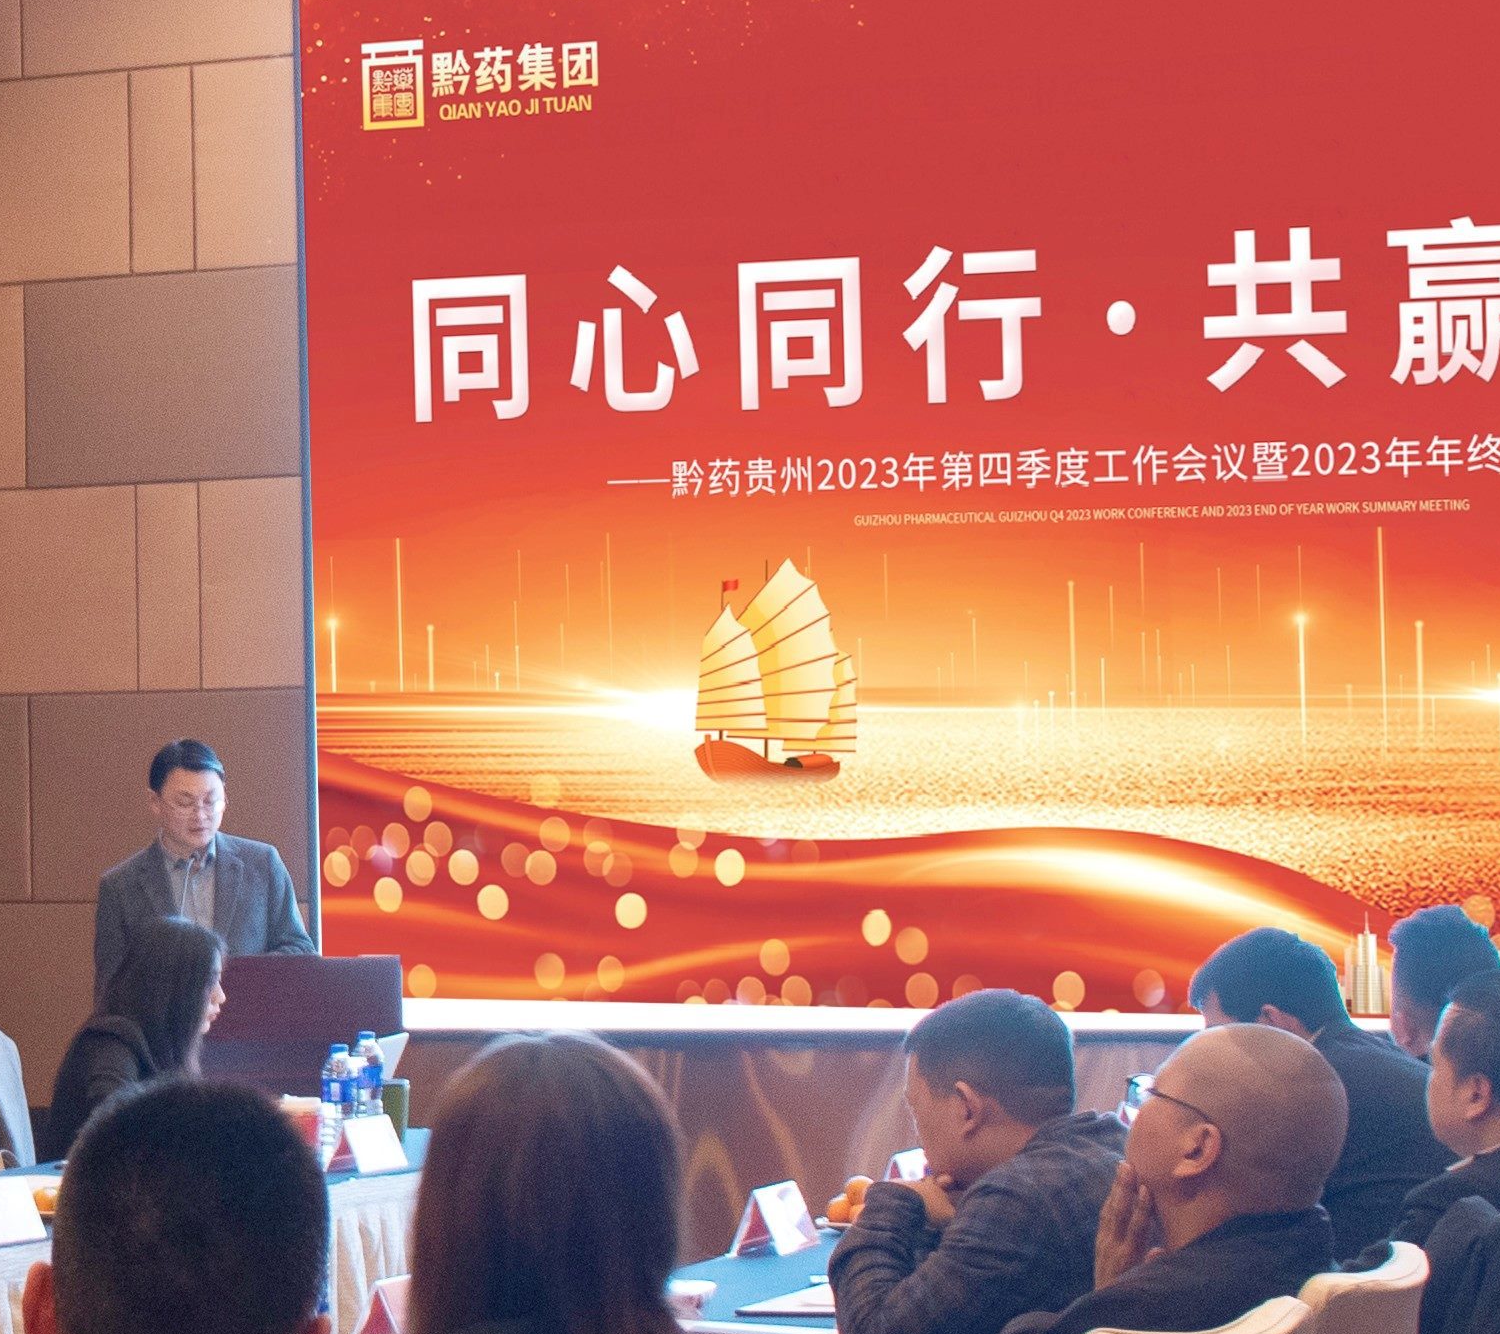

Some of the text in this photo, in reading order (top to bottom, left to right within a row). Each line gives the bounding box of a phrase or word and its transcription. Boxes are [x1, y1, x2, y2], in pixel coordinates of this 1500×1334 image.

[430, 40, 600, 98] 黔药集团
[438, 94, 593, 121] QIAN YAO JI TUAN
[853, 498, 1470, 527] GUIZHOU PHARMACEUTICAL GUIZHOU Q4 2023 WORK CONFERENCE AND 2023 END OF YEAR WORK SUMMARY MEETING
